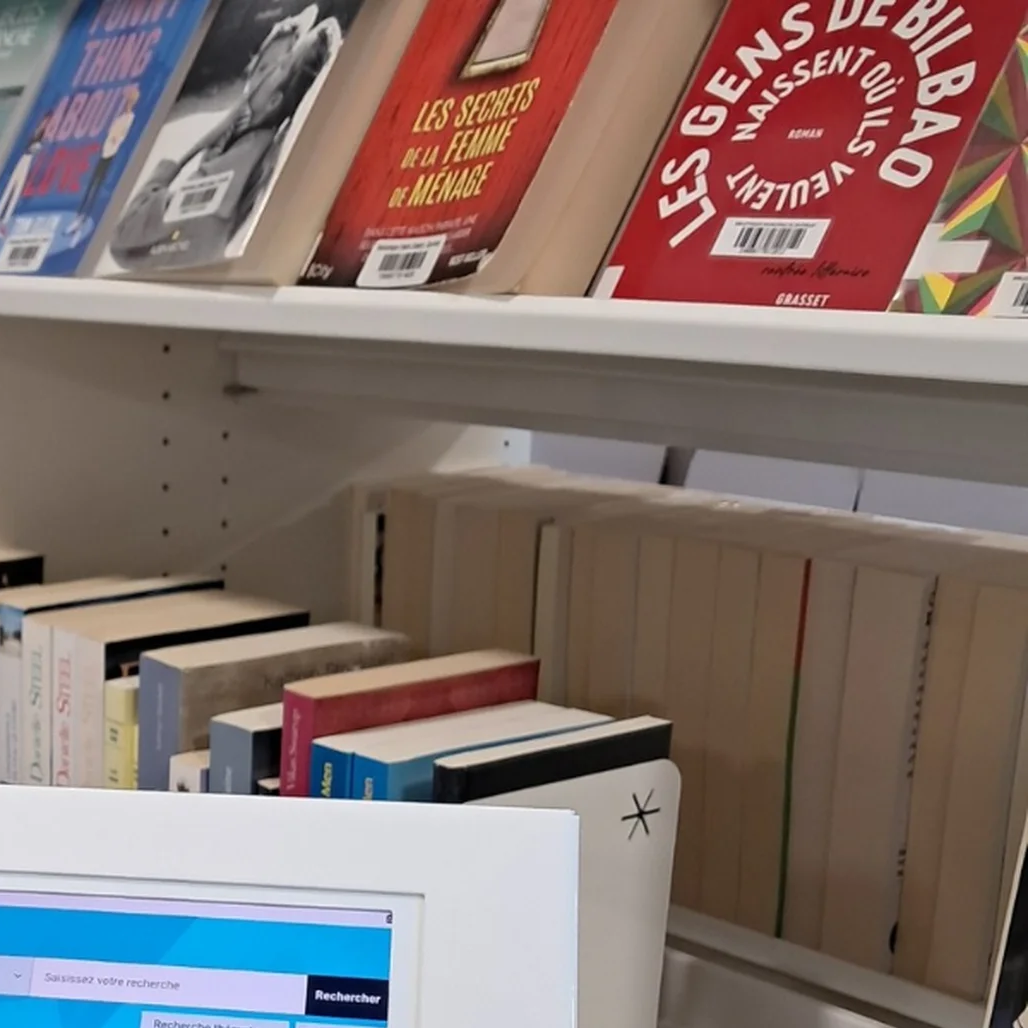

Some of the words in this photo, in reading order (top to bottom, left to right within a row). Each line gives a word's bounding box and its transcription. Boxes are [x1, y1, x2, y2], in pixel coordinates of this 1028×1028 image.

[826, 0, 898, 33] DE
[73, 27, 162, 87] THING
[680, 2, 815, 137] GENS
[412, 96, 456, 133] LES
[453, 77, 541, 129] SECRETS
[730, 45, 876, 142] NAISSENT
[860, 61, 905, 105] OÙ
[878, 0, 977, 188] BILBAO
[38, 82, 140, 142] ABOUT
[787, 128, 824, 140] ROMAN
[847, 106, 894, 157] ILS
[400, 147, 422, 169] DE
[420, 144, 441, 166] LA
[442, 117, 519, 165] FEMME
[388, 186, 411, 208] DE
[406, 161, 495, 207] MÉNAGE
[658, 148, 717, 249] LES
[725, 161, 855, 212] VEULENT
[775, 292, 831, 308] GRASSET
[44, 972, 95, 985] Saisissez
[97, 976, 124, 987] votre
[126, 977, 180, 991] recherche
[314, 989, 382, 1005] Rechercher
